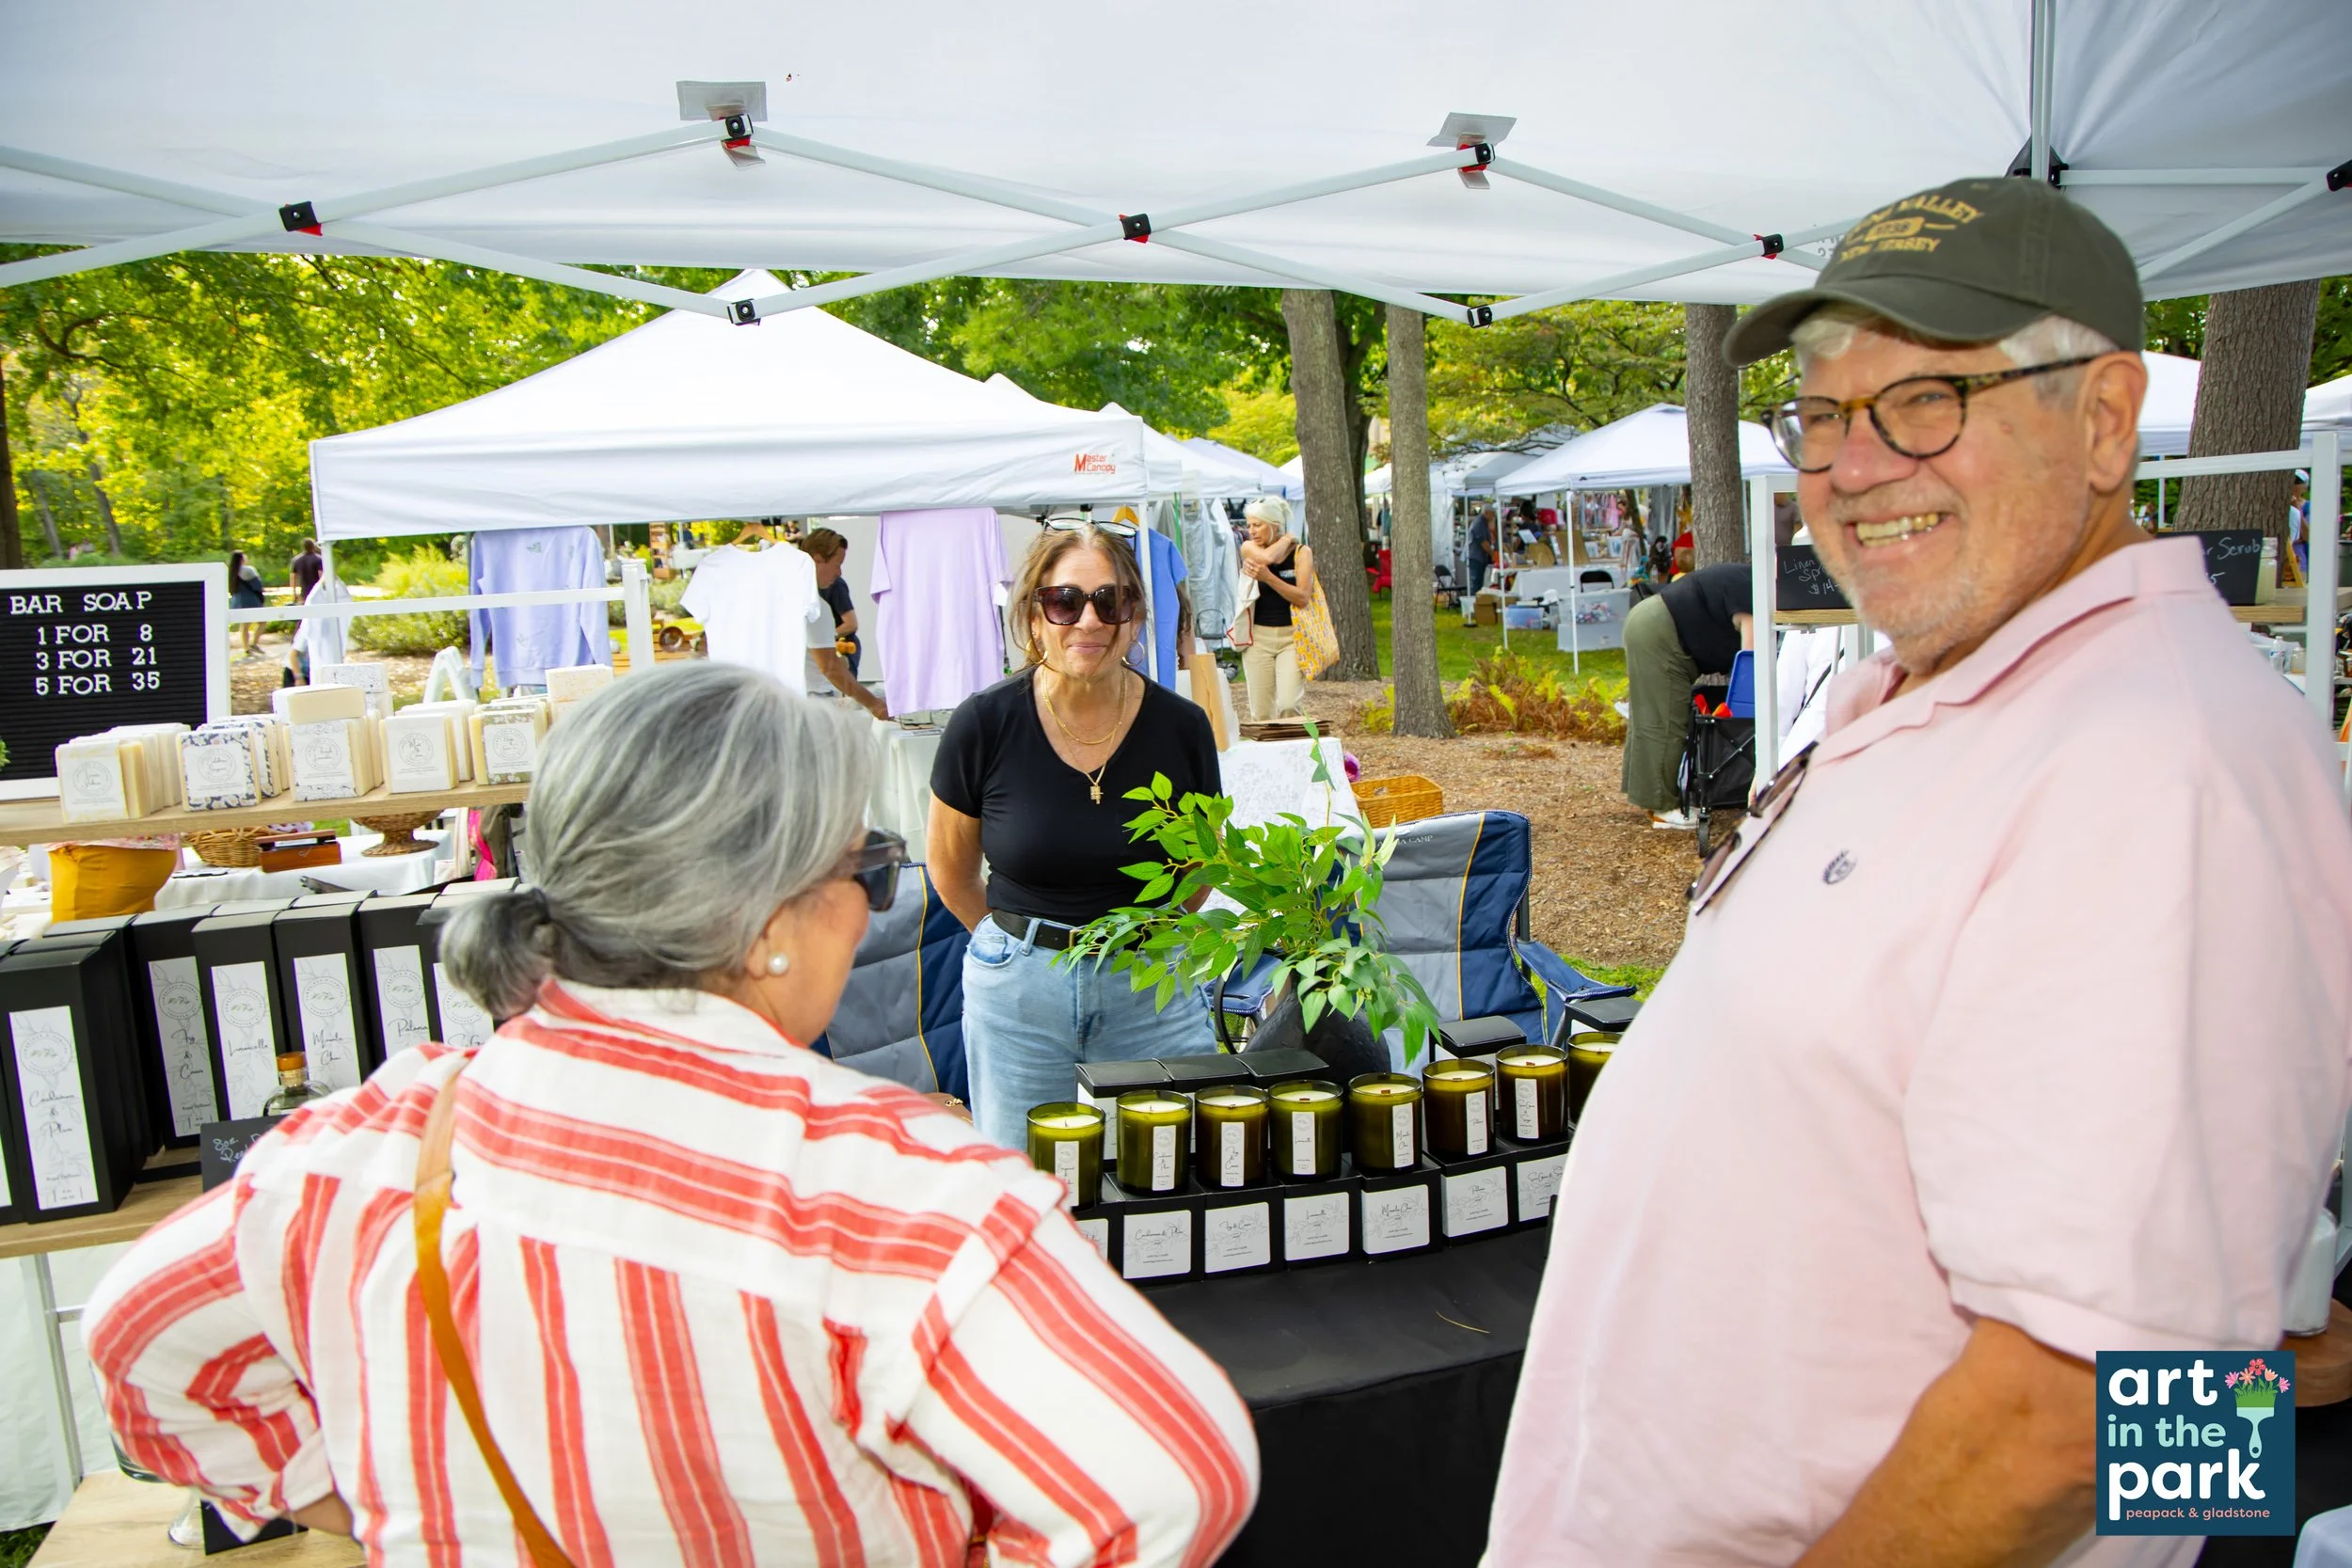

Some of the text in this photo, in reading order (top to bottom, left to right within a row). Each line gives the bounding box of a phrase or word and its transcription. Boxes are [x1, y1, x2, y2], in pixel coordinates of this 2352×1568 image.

[2217, 537, 2260, 560] Scrub
[1784, 559, 1815, 574] Linen
[9, 591, 152, 615] BAR SOAP
[38, 624, 152, 645] 1 FOR 8
[36, 646, 157, 670] 3 FOR 21
[36, 672, 160, 695] 5 FOR 35
